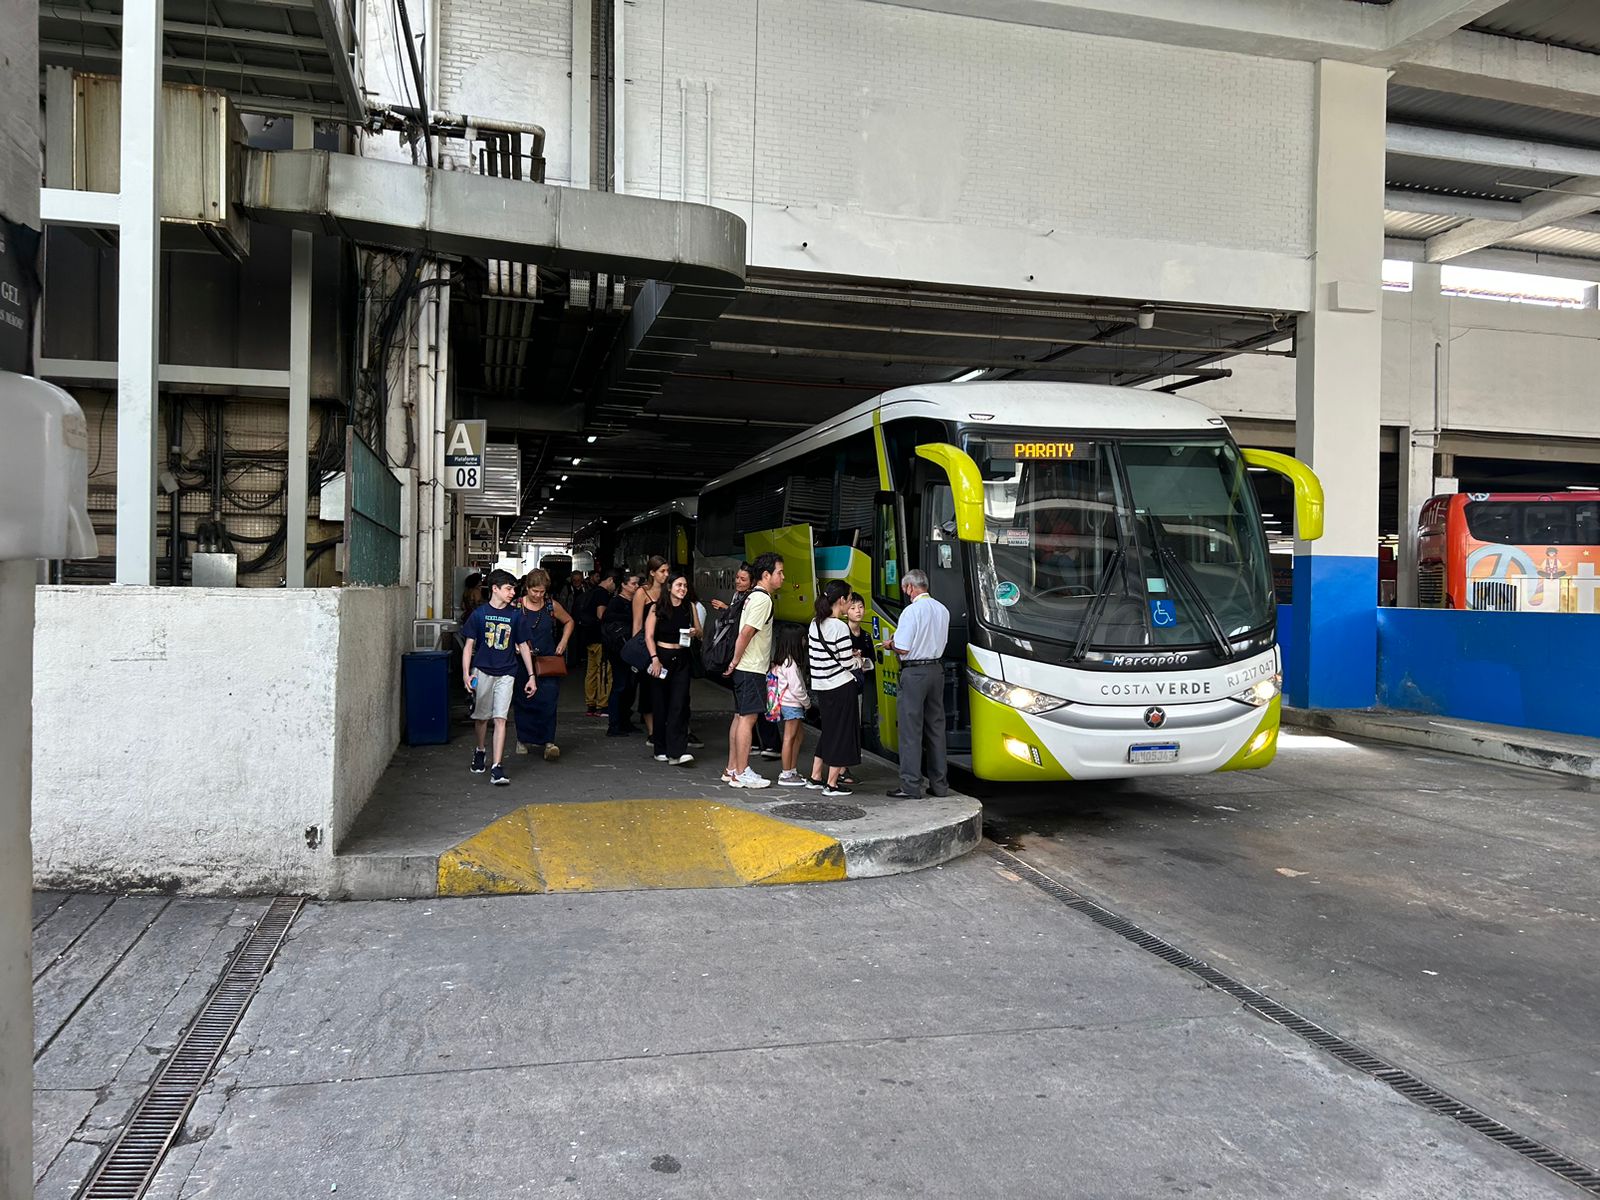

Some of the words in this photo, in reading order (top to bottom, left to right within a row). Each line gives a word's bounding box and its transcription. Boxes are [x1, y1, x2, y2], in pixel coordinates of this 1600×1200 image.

[1, 281, 21, 306] GEL
[446, 423, 474, 456] A
[1014, 443, 1074, 458] PARATY
[456, 468, 477, 487] 08
[475, 517, 492, 535] A
[1112, 654, 1188, 667] Marcopolo
[1226, 675, 1240, 688] RJ
[1243, 667, 1258, 682] 217
[1259, 659, 1275, 675] 047
[1100, 684, 1150, 696] COSTA
[1155, 681, 1211, 695] VERDE
